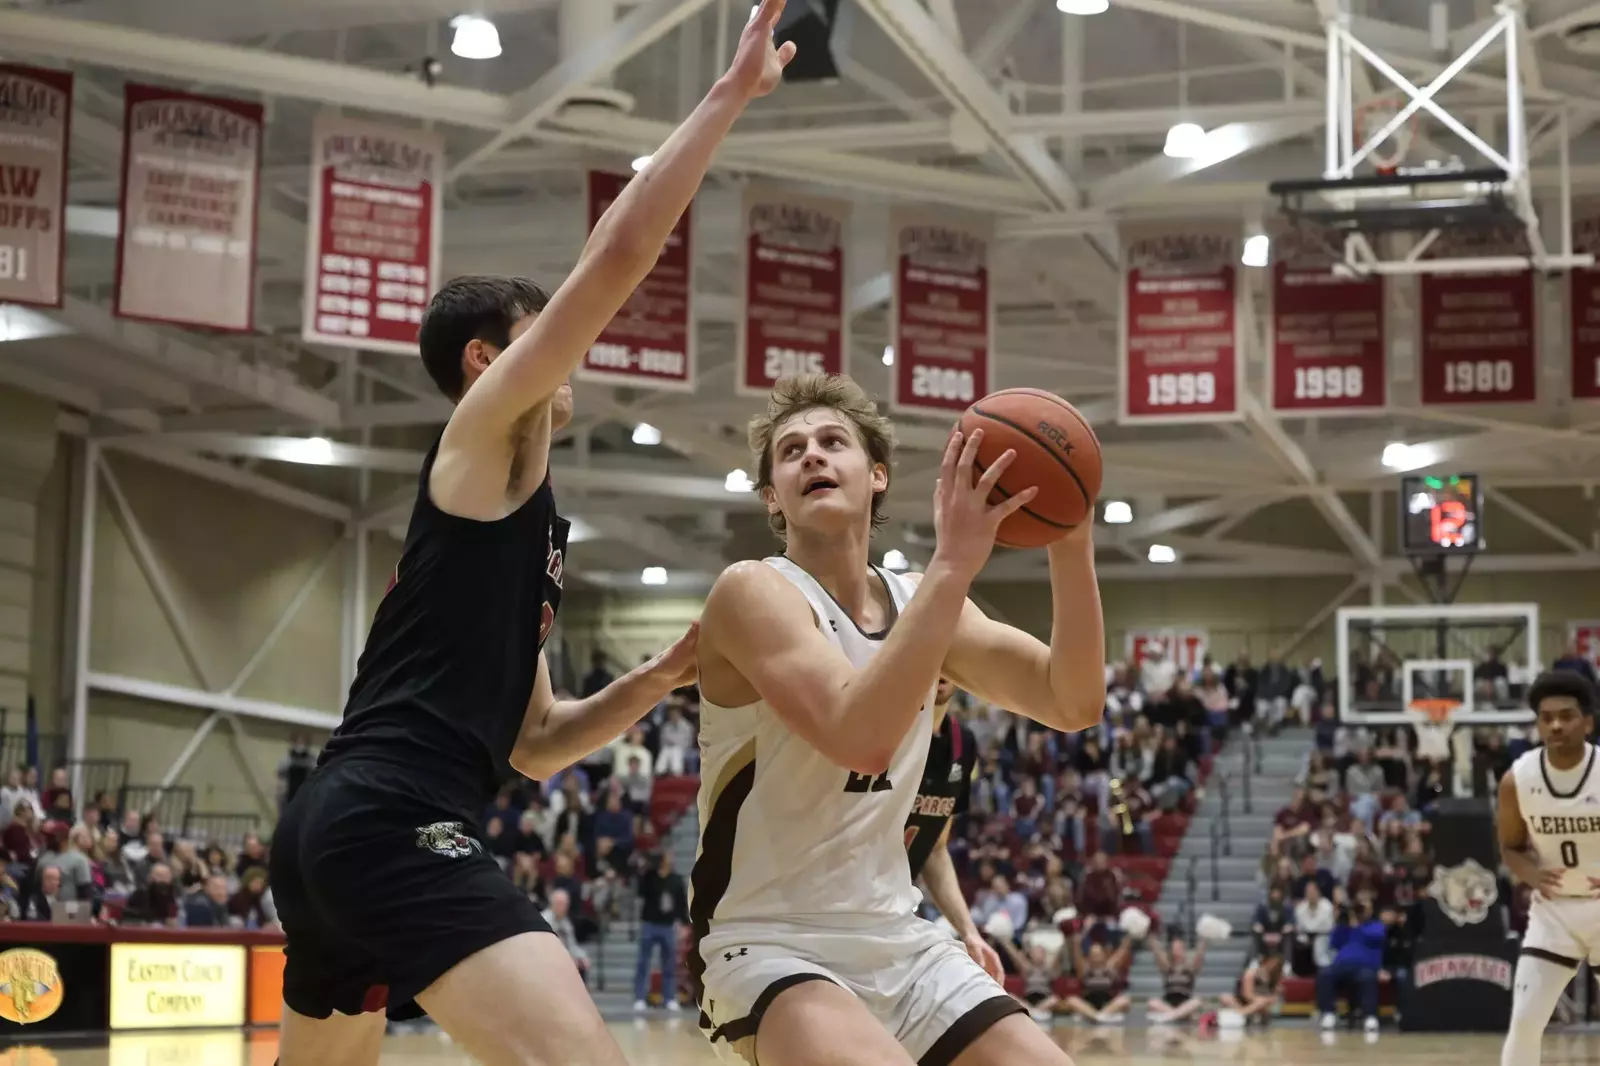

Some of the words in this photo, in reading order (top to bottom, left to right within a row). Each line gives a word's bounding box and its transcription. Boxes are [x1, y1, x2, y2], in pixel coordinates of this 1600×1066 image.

[1147, 372, 1215, 406] 1999
[1294, 366, 1363, 400] 1998
[1443, 360, 1514, 394] 1980
[1529, 815, 1600, 835] LEHIGH
[1561, 840, 1579, 869] 0
